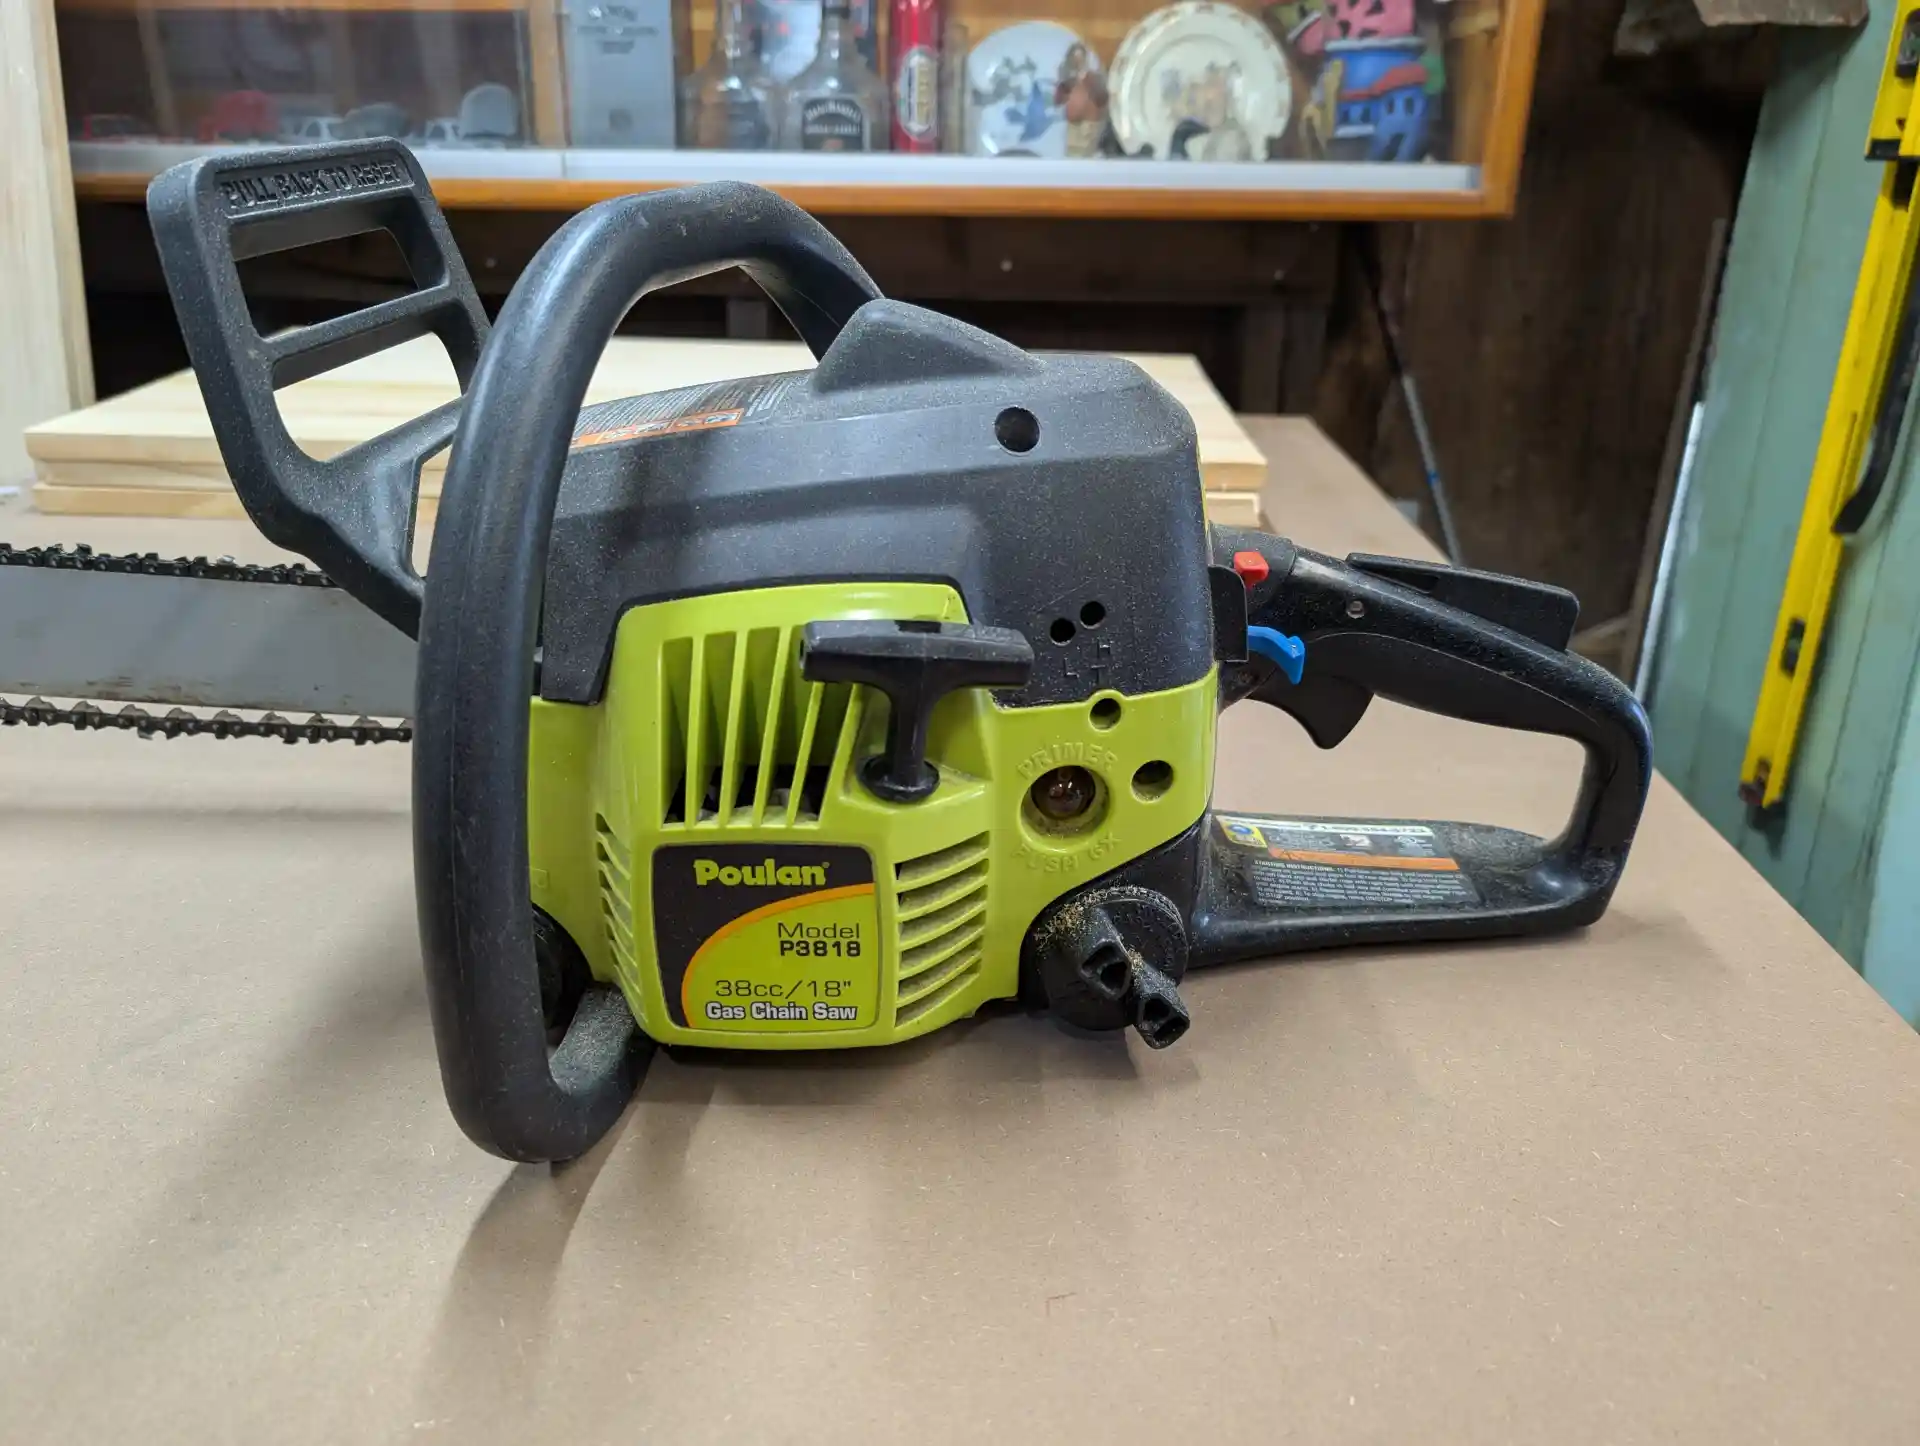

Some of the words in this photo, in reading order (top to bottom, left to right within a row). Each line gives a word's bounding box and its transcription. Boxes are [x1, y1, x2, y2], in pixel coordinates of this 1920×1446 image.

[220, 177, 278, 208] PULL
[273, 169, 330, 200] BACK
[325, 165, 352, 192] TO
[351, 160, 401, 188] RESET
[1016, 742, 1119, 779] PRIMER
[693, 858, 827, 886] Poulan
[777, 922, 861, 939] Model
[780, 940, 861, 957] P3818
[715, 979, 852, 1000] 38cc/18"
[705, 1001, 746, 1019] Gas
[750, 1001, 809, 1021] Chain
[813, 1002, 858, 1021] Saw
